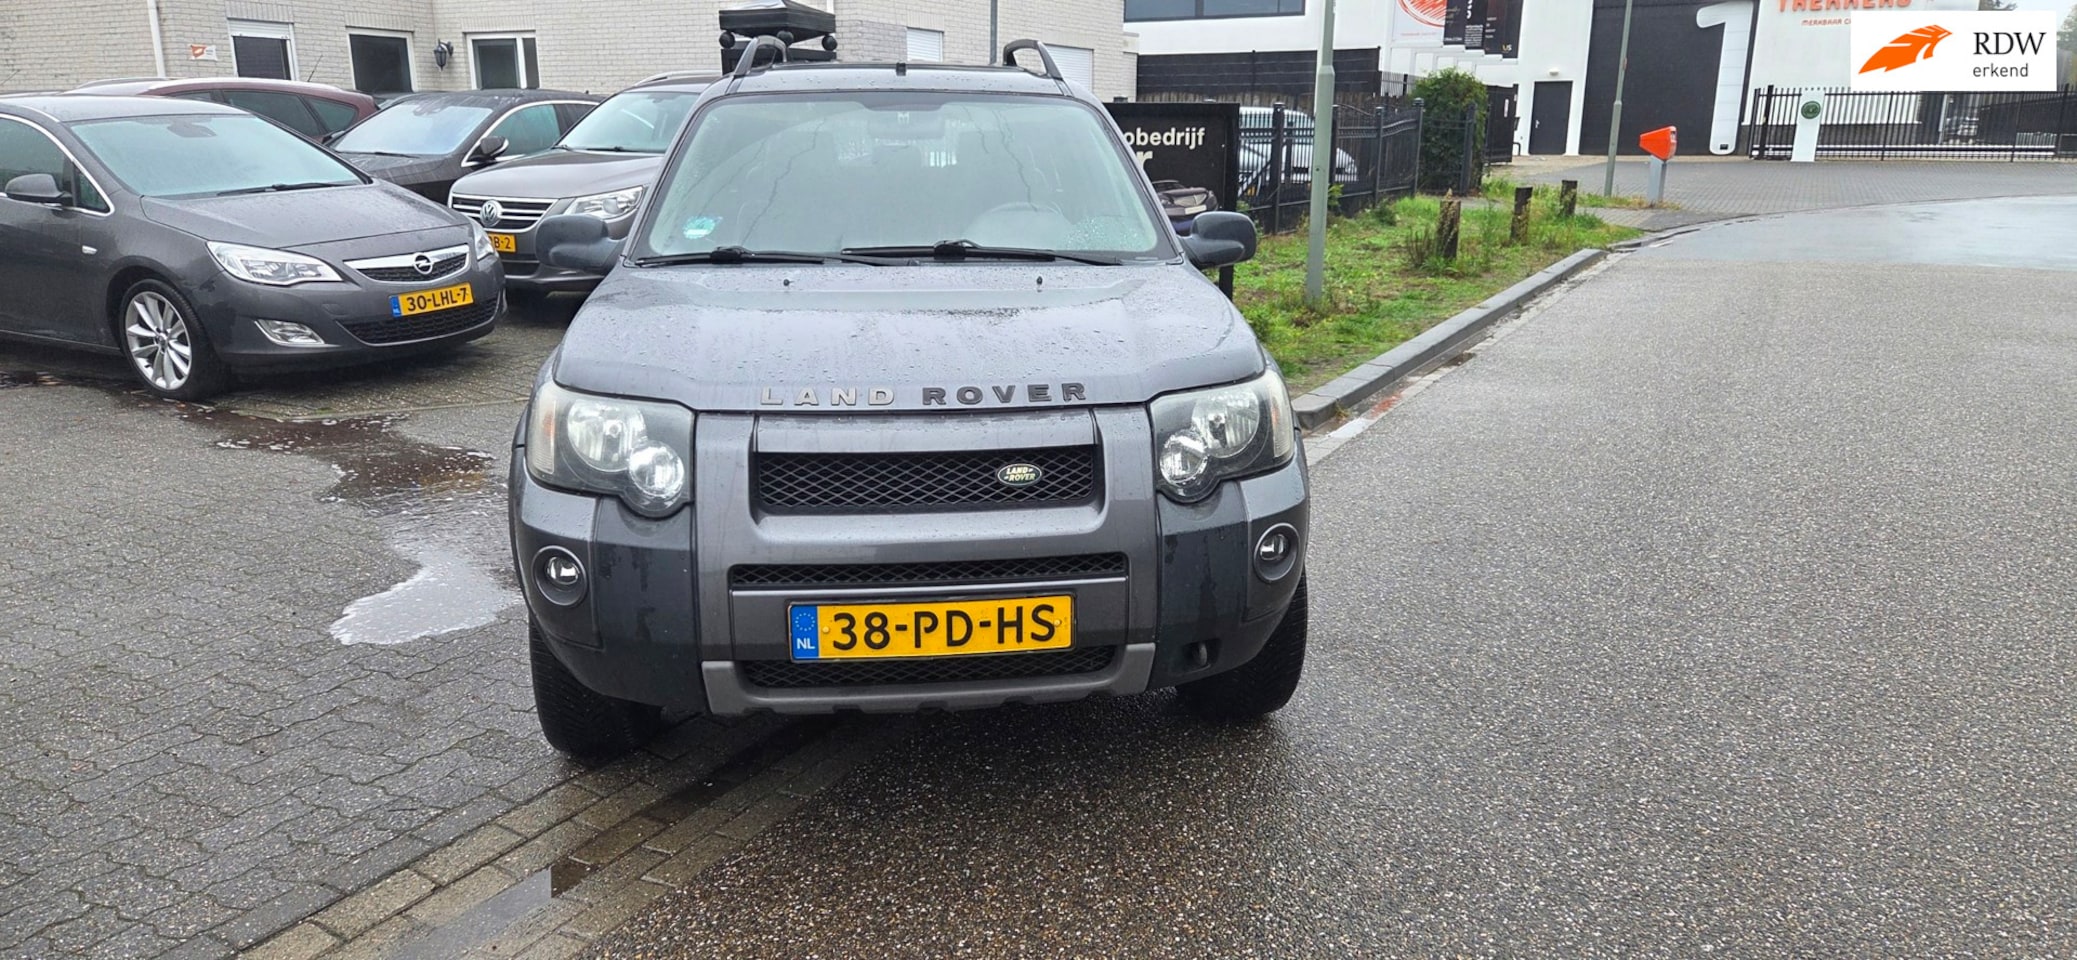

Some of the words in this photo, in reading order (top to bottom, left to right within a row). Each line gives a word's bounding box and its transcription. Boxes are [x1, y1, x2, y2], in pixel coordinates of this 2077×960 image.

[406, 287, 467, 312] 30-LHL-7
[760, 386, 896, 406] LAND
[922, 382, 1087, 406] ROVER
[796, 637, 815, 650] NL
[832, 603, 1056, 651] 38-PD-HS
